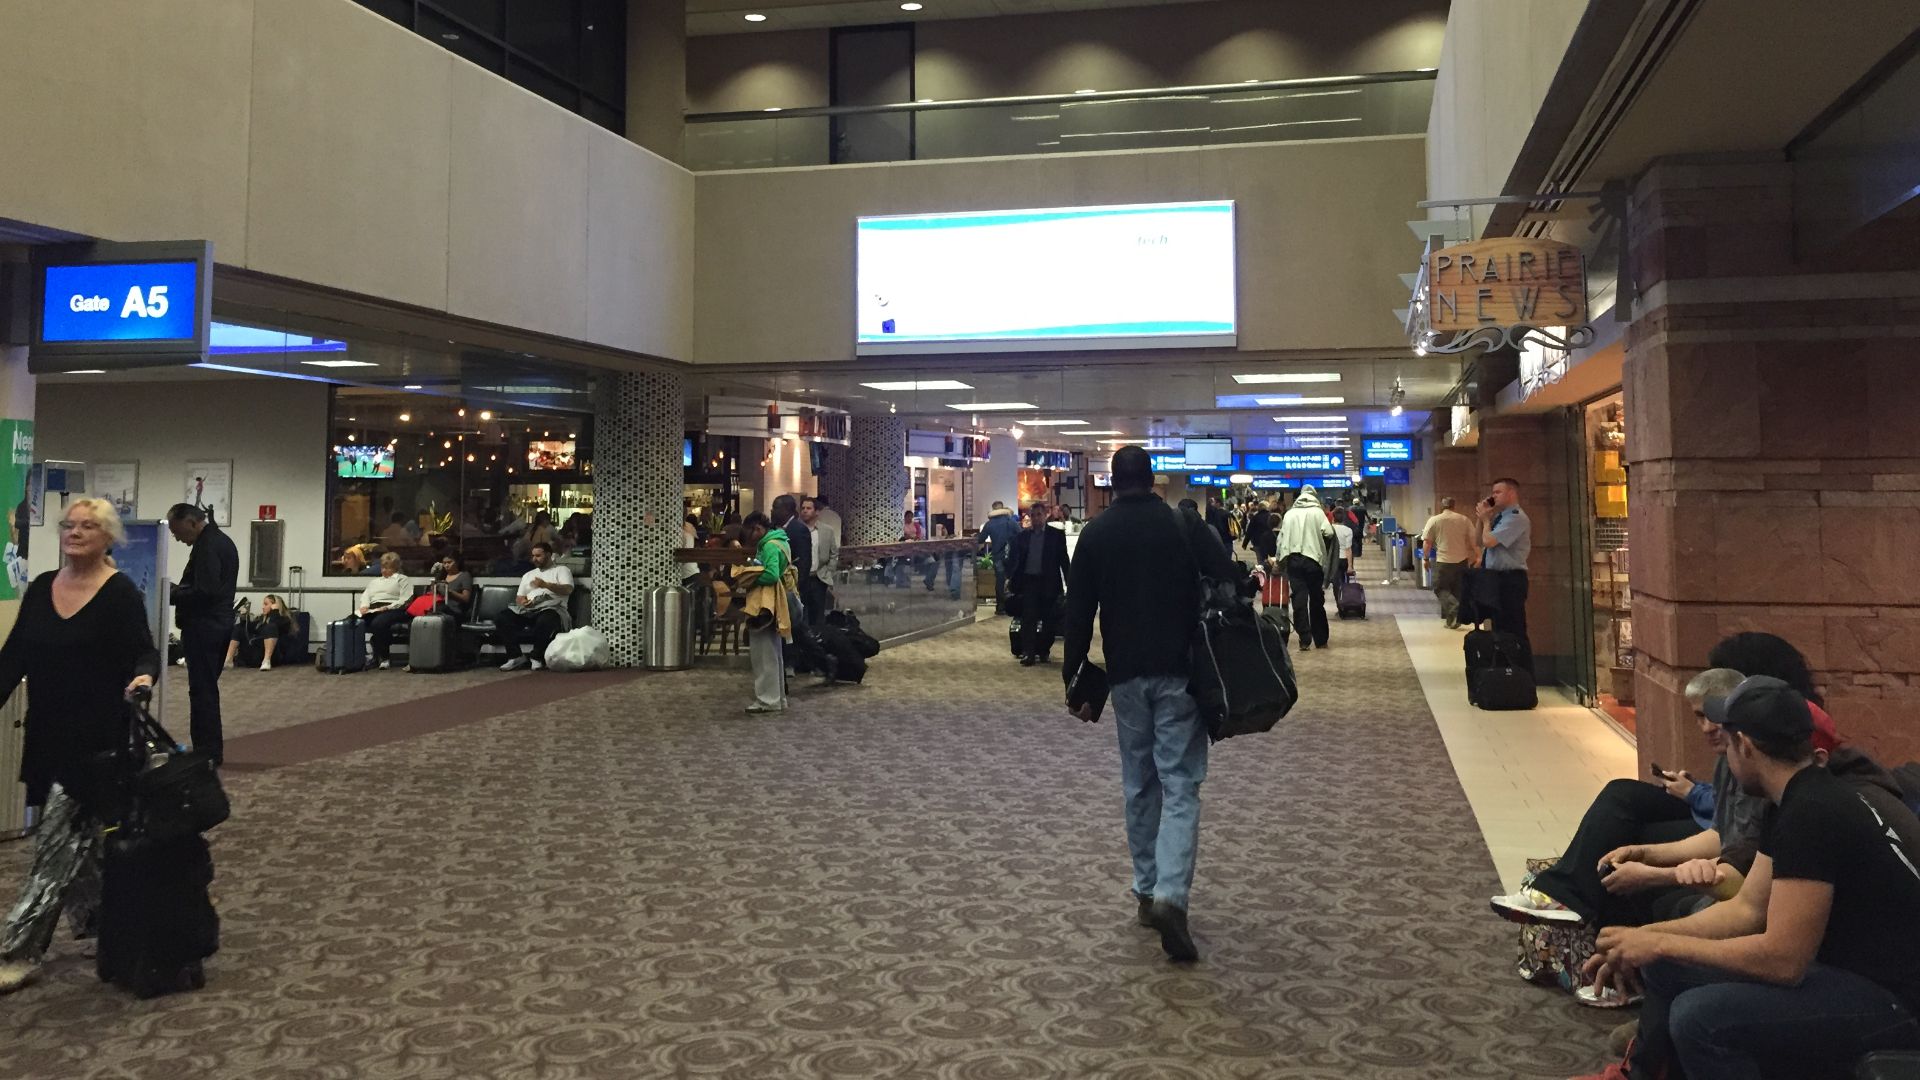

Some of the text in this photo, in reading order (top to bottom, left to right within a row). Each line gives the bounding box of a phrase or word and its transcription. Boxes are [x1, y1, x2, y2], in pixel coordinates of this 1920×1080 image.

[1436, 250, 1577, 283] PRAIRIE
[69, 285, 169, 319] Gate A5
[1436, 285, 1578, 323] NEWS
